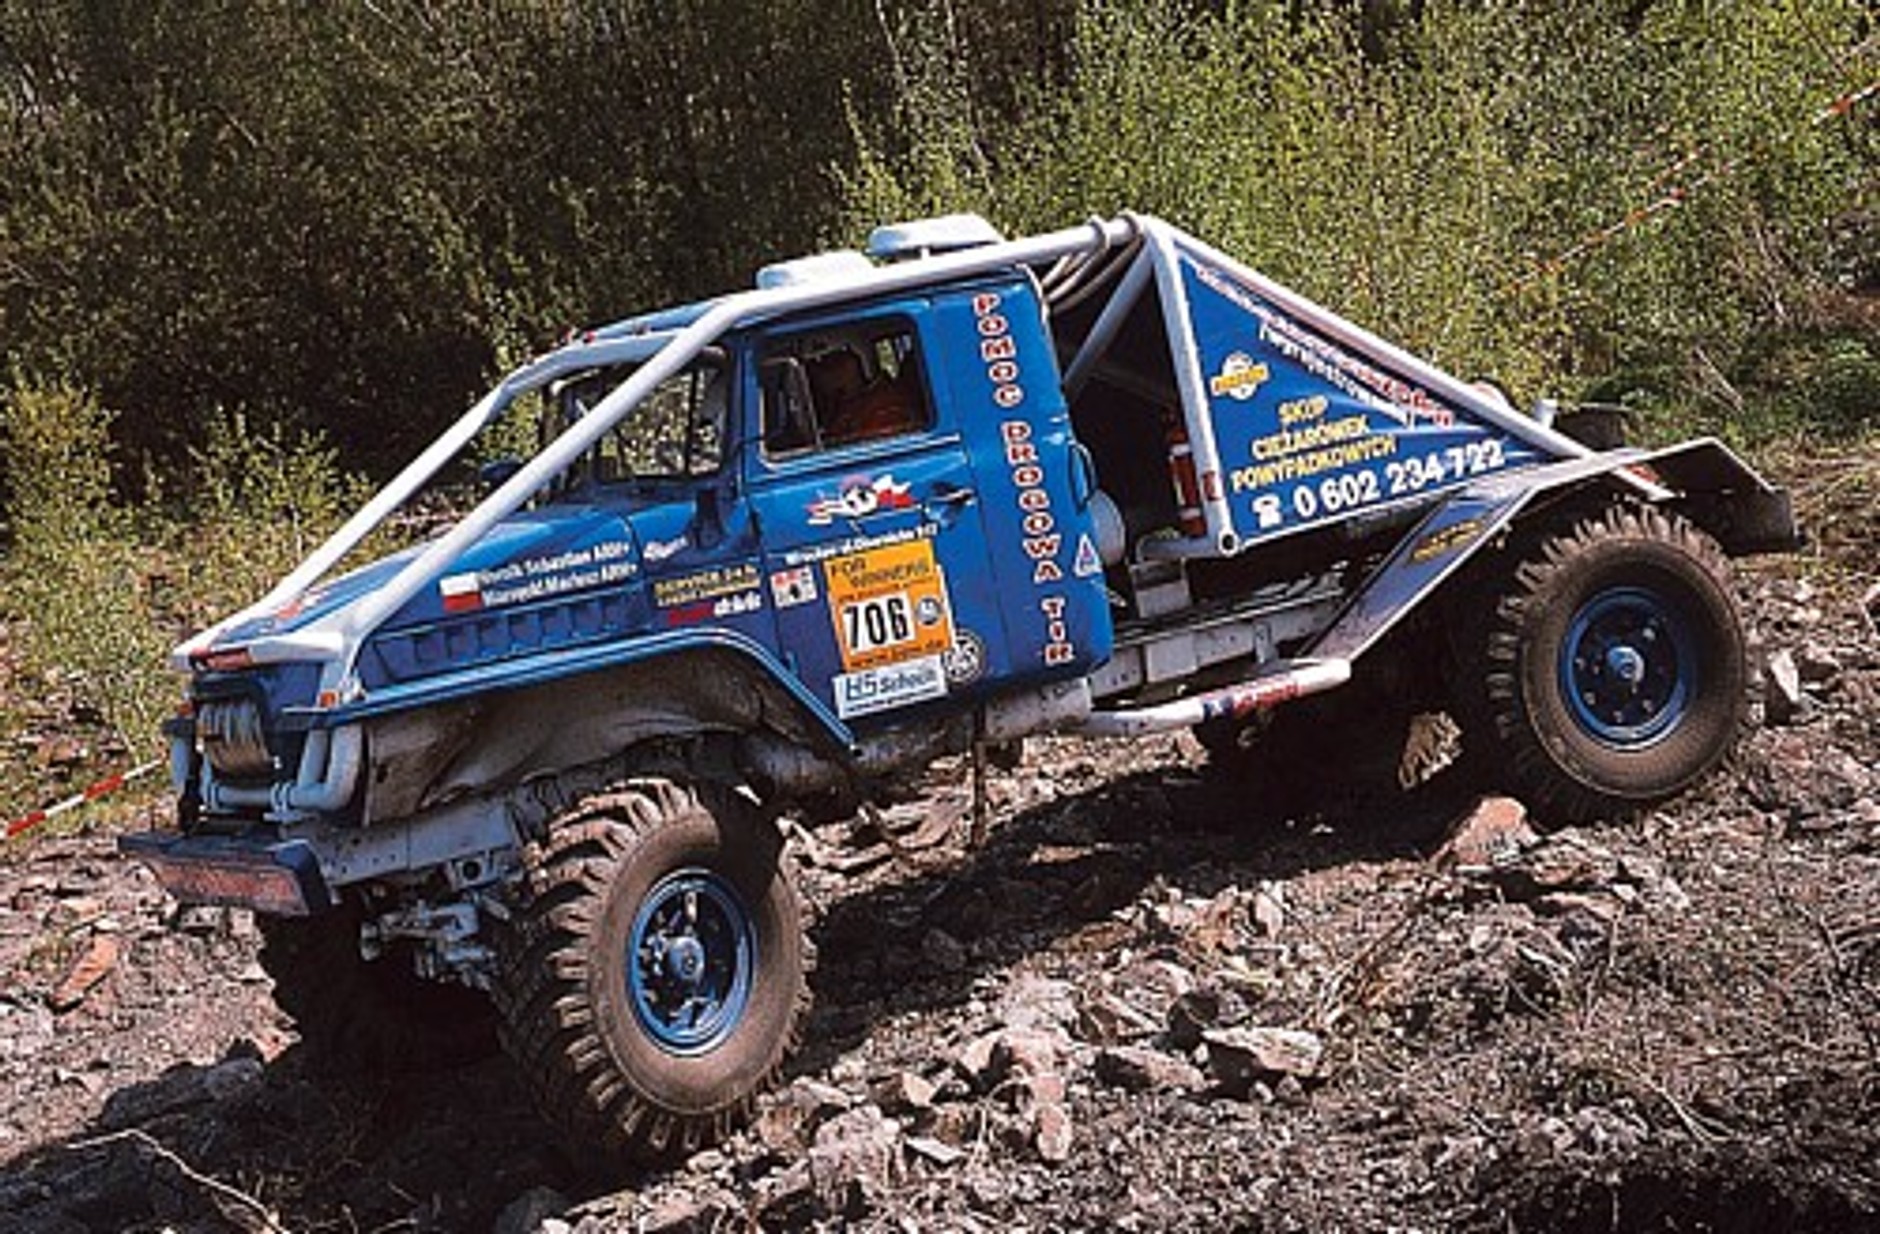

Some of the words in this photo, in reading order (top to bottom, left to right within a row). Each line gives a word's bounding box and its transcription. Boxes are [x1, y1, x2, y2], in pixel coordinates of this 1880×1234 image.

[973, 293, 1024, 408] POMOC
[1278, 394, 1329, 424] SKUP
[1230, 433, 1397, 493] POWYPADKOWYCH
[1293, 484, 1317, 517] 0
[1319, 469, 1381, 511] 602
[1385, 452, 1445, 494] 234
[1446, 438, 1506, 478] 722
[1001, 421, 1063, 582] DROGOWA
[831, 557, 866, 578] FOR
[851, 560, 931, 589] WINNERS
[843, 597, 910, 650] 706
[1041, 597, 1074, 665] TIR
